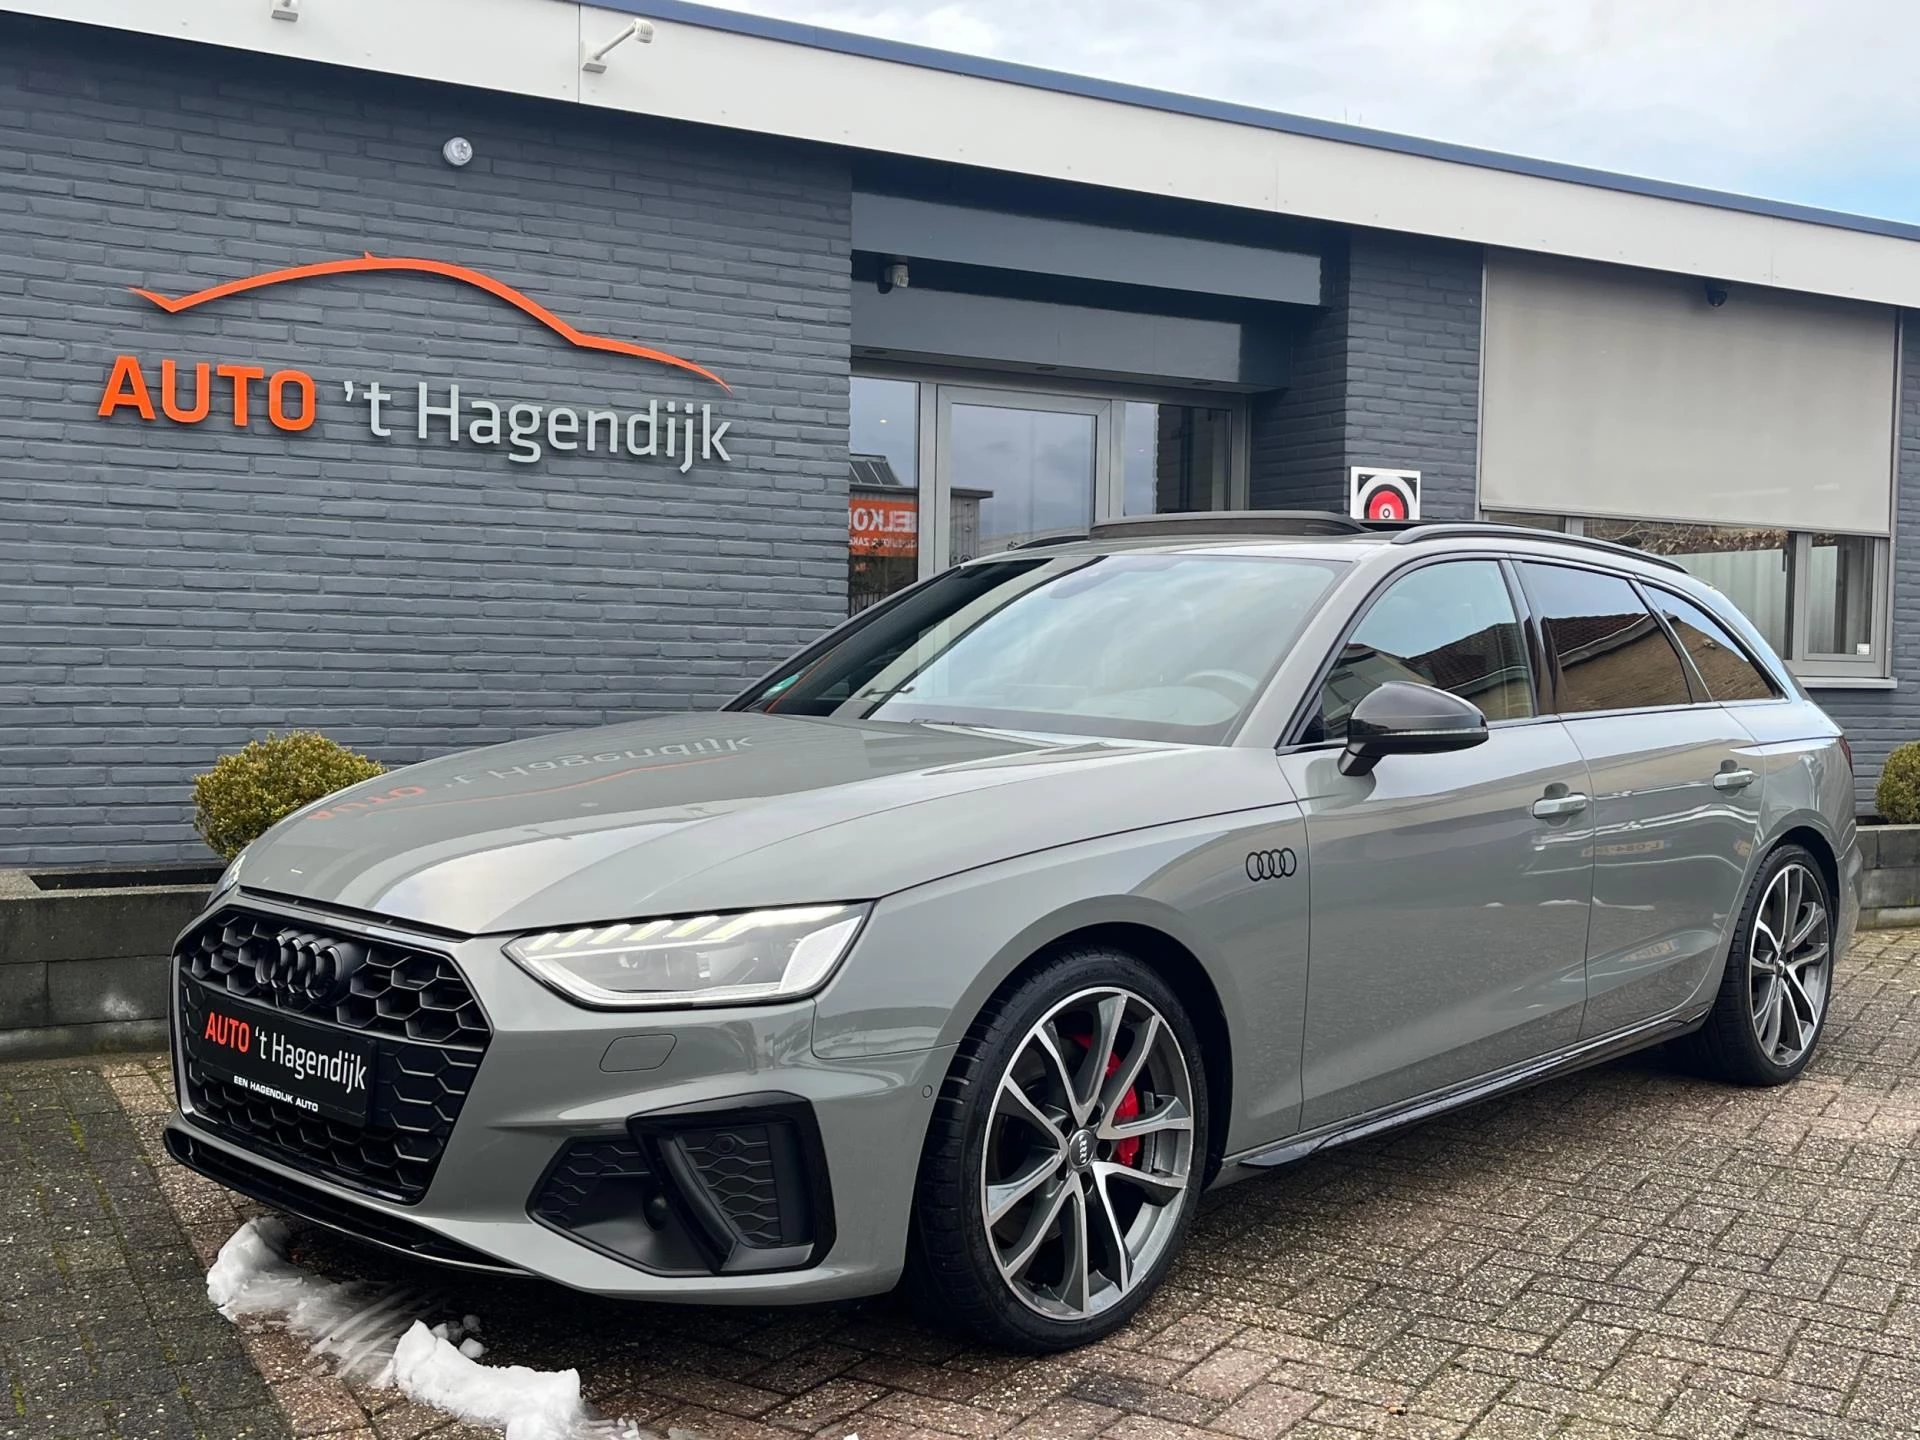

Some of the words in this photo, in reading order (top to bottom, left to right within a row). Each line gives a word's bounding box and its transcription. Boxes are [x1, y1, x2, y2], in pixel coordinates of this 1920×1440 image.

[97, 354, 316, 431] AUTO
[343, 379, 391, 437] 't
[418, 380, 732, 474] Hagendijk
[204, 1011, 250, 1053] AUTO
[255, 1026, 267, 1059] 't
[271, 1032, 367, 1094] Hagendijk
[233, 1075, 248, 1088] EEN
[250, 1081, 293, 1104] HAGENDIJK
[295, 1097, 319, 1112] AUTO
